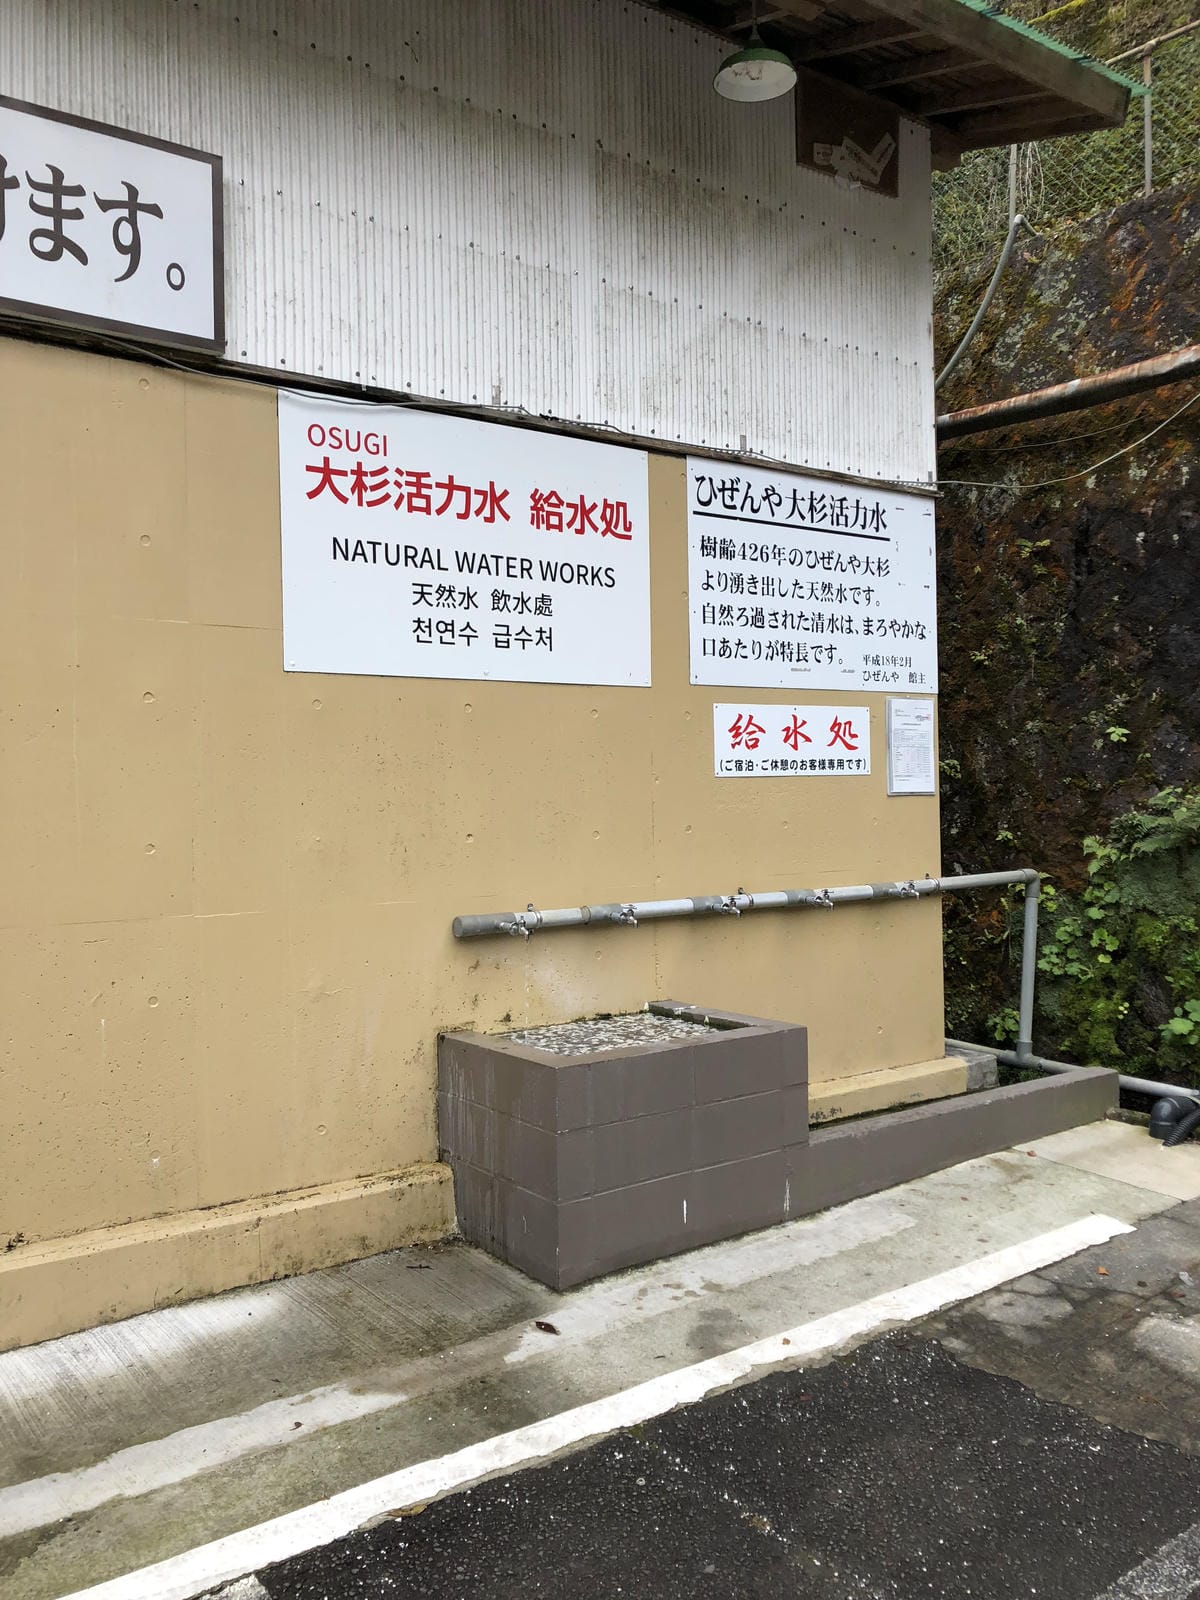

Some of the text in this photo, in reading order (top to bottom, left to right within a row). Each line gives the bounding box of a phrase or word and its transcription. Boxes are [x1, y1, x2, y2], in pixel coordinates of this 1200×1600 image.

[307, 423, 388, 456] OSUGI
[305, 456, 633, 540] 大杉活力水 給水処
[695, 475, 887, 532] ひぜんや大杉活力水
[332, 537, 616, 587] NATURAL WATER WORKS
[700, 535, 890, 577] 樹齢426年のひぜんや大杉
[412, 582, 553, 616] 天然水 飲水處
[701, 570, 881, 607] より湧き出した天然水です。
[412, 618, 553, 651] 천연수 급수처
[702, 603, 927, 640] 自然ろ過された清水は、まろやかな
[703, 637, 844, 665] 口あたりが特長です。
[862, 654, 912, 667] 平成18年2月
[862, 670, 899, 682] ひぜんや
[909, 672, 926, 684] 館主
